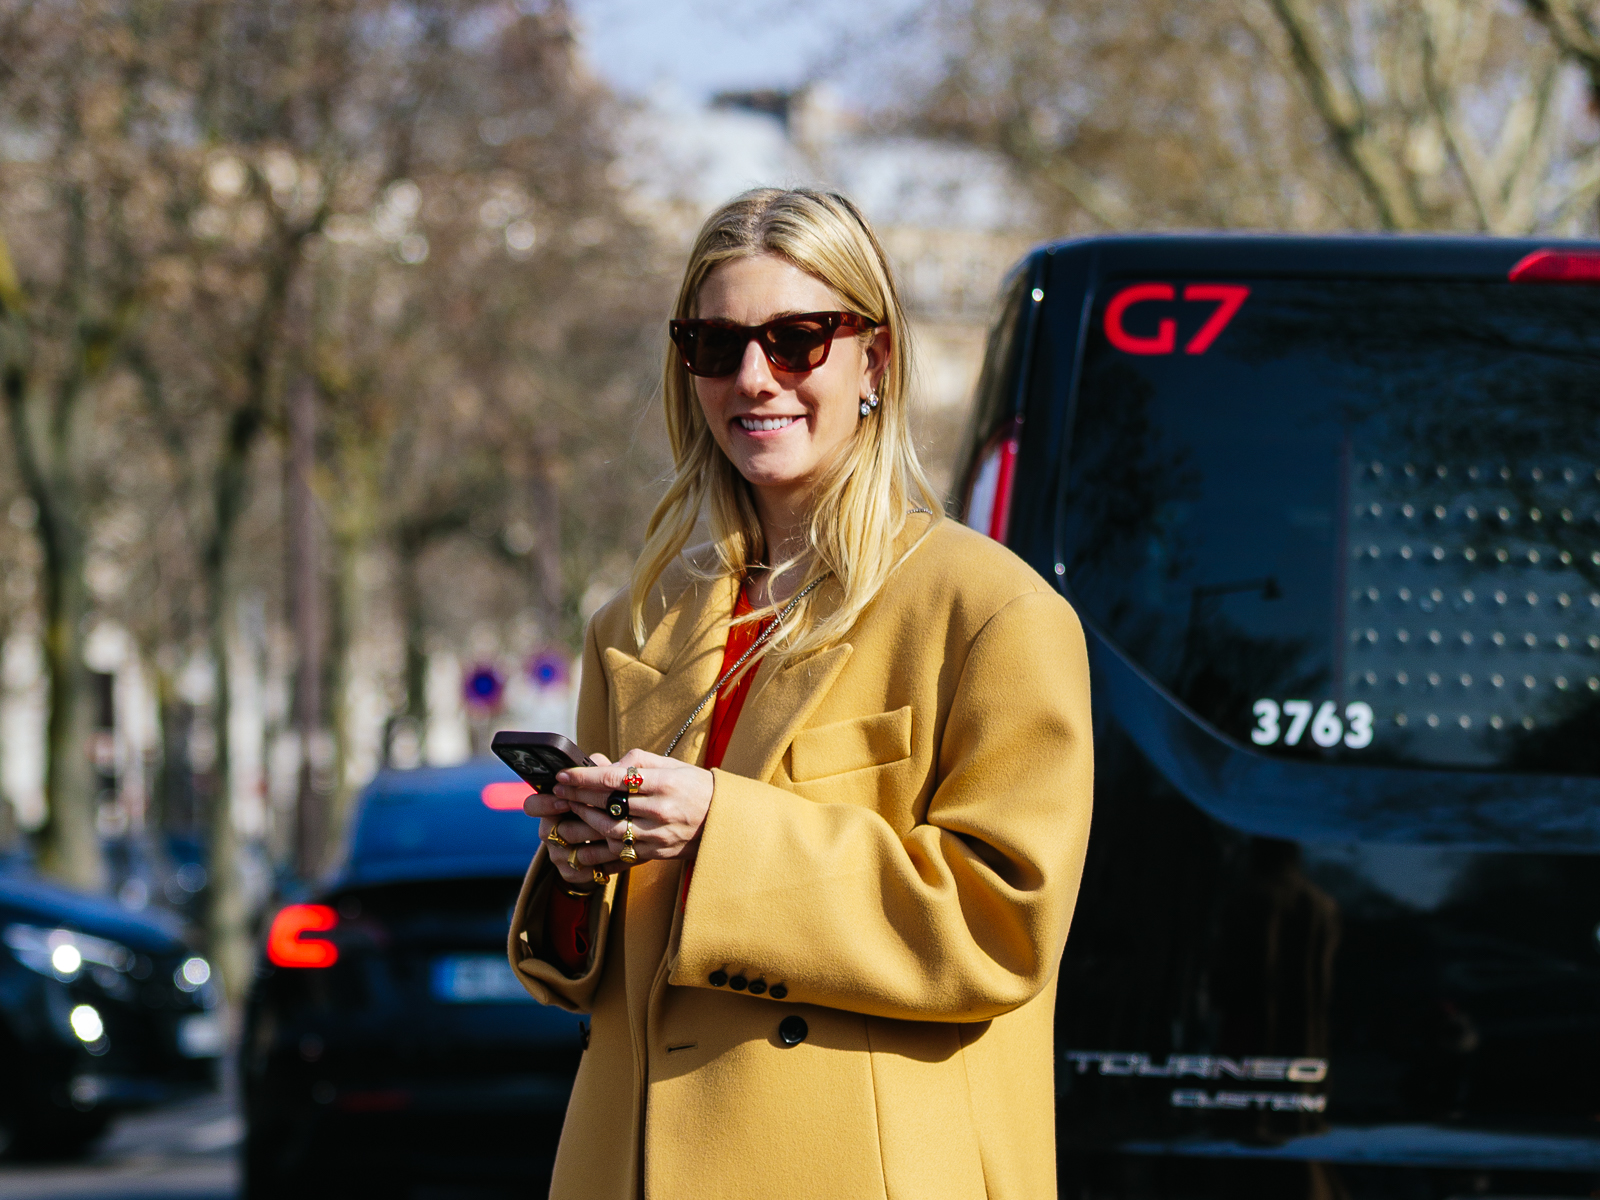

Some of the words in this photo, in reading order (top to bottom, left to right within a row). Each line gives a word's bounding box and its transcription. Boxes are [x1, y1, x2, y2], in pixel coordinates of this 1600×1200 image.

[1103, 282, 1250, 355] G7
[1251, 698, 1374, 749] 3763
[1064, 1051, 1328, 1082] TOURNEO
